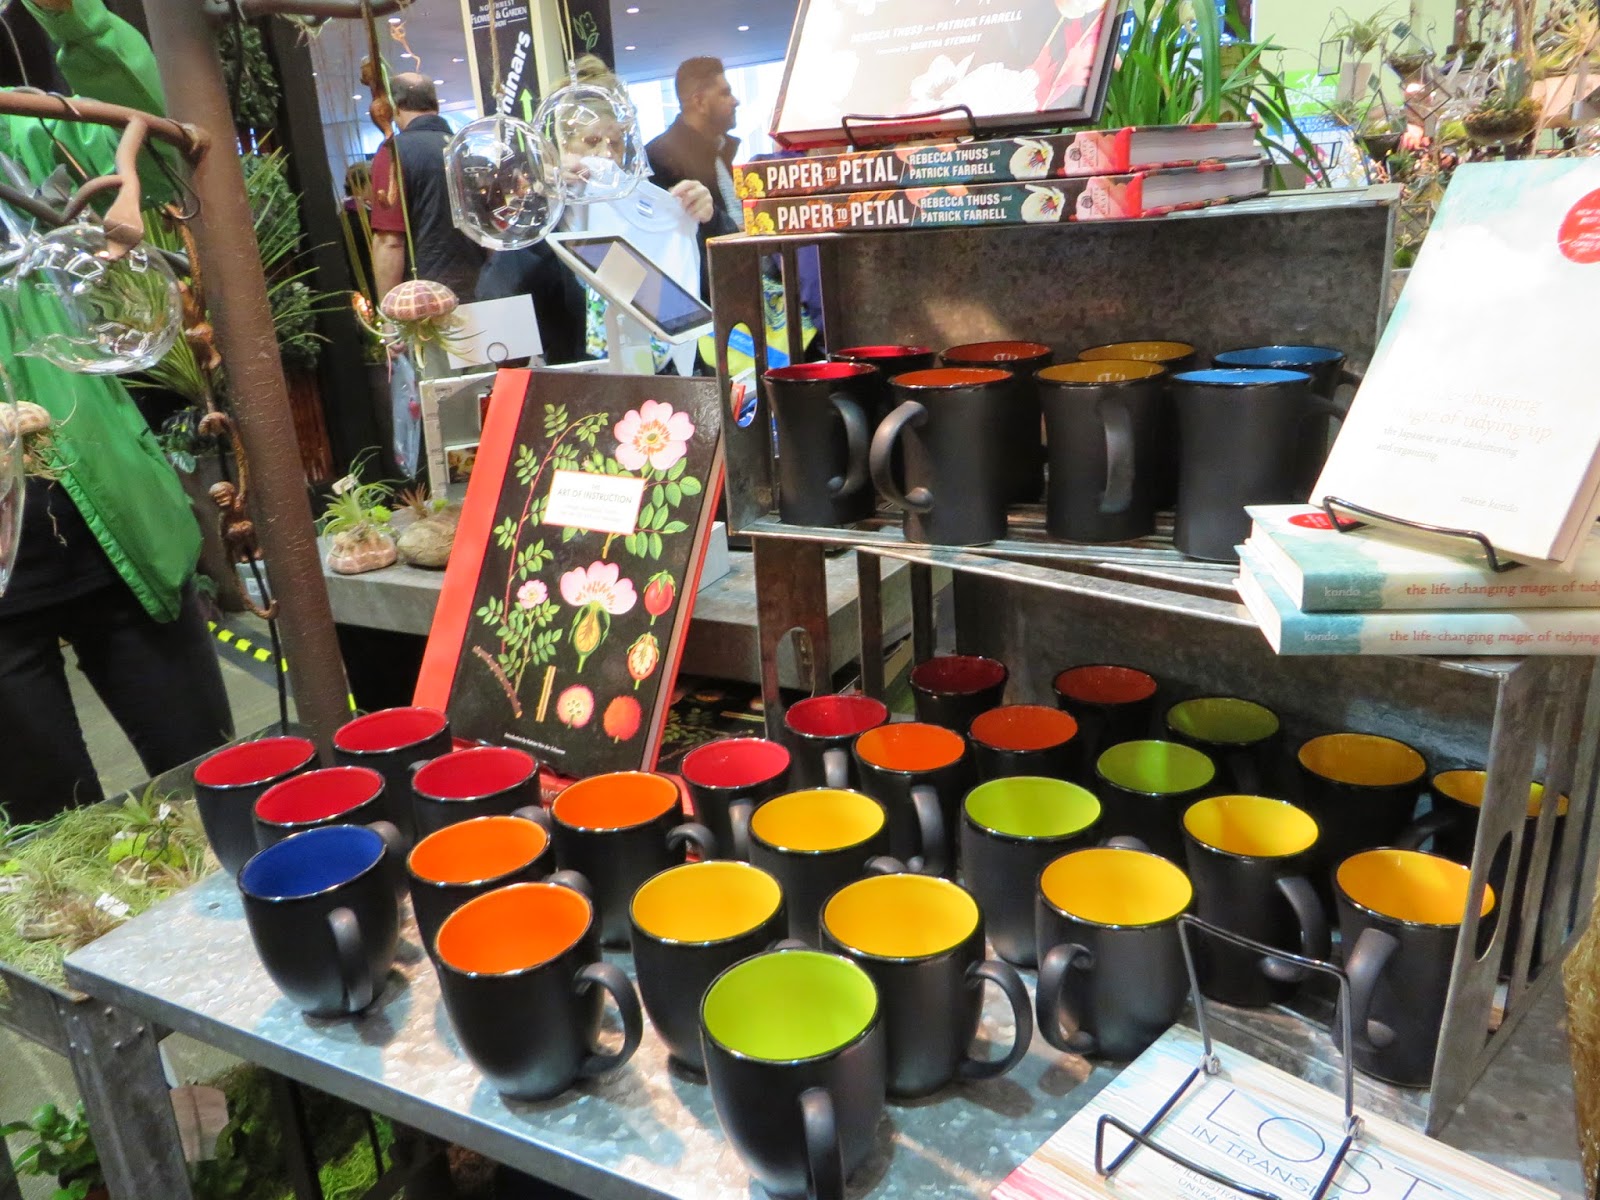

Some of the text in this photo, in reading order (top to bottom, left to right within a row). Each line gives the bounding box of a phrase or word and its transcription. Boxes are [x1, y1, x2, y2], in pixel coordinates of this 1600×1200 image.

[936, 17, 978, 32] PATRICK
[979, 10, 1022, 26] FARRELL
[944, 33, 983, 47] STEWART
[909, 150, 952, 166] REBECCA
[955, 147, 989, 162] THUSS
[766, 156, 898, 190] PAPER TO PETAL
[909, 161, 995, 180] PATRICK FARRELL
[920, 195, 964, 209] REBECCA
[967, 193, 1000, 206] THUSS
[777, 199, 909, 230] PAPER TO PETAL
[920, 206, 1007, 223] PATRICK FARRELL
[1384, 426, 1398, 437] the
[1450, 438, 1461, 447] of
[1463, 414, 1522, 441] tidying
[1528, 424, 1552, 444] up
[1376, 442, 1392, 453] and
[558, 488, 633, 504] ART OF INSTRUCTION
[1323, 580, 1600, 597] kondo the life-changing magic of tid
[1304, 630, 1600, 646] kondo the life-changing magic of tidying
[1191, 1125, 1218, 1146] IN
[1207, 1089, 1443, 1200] LOST
